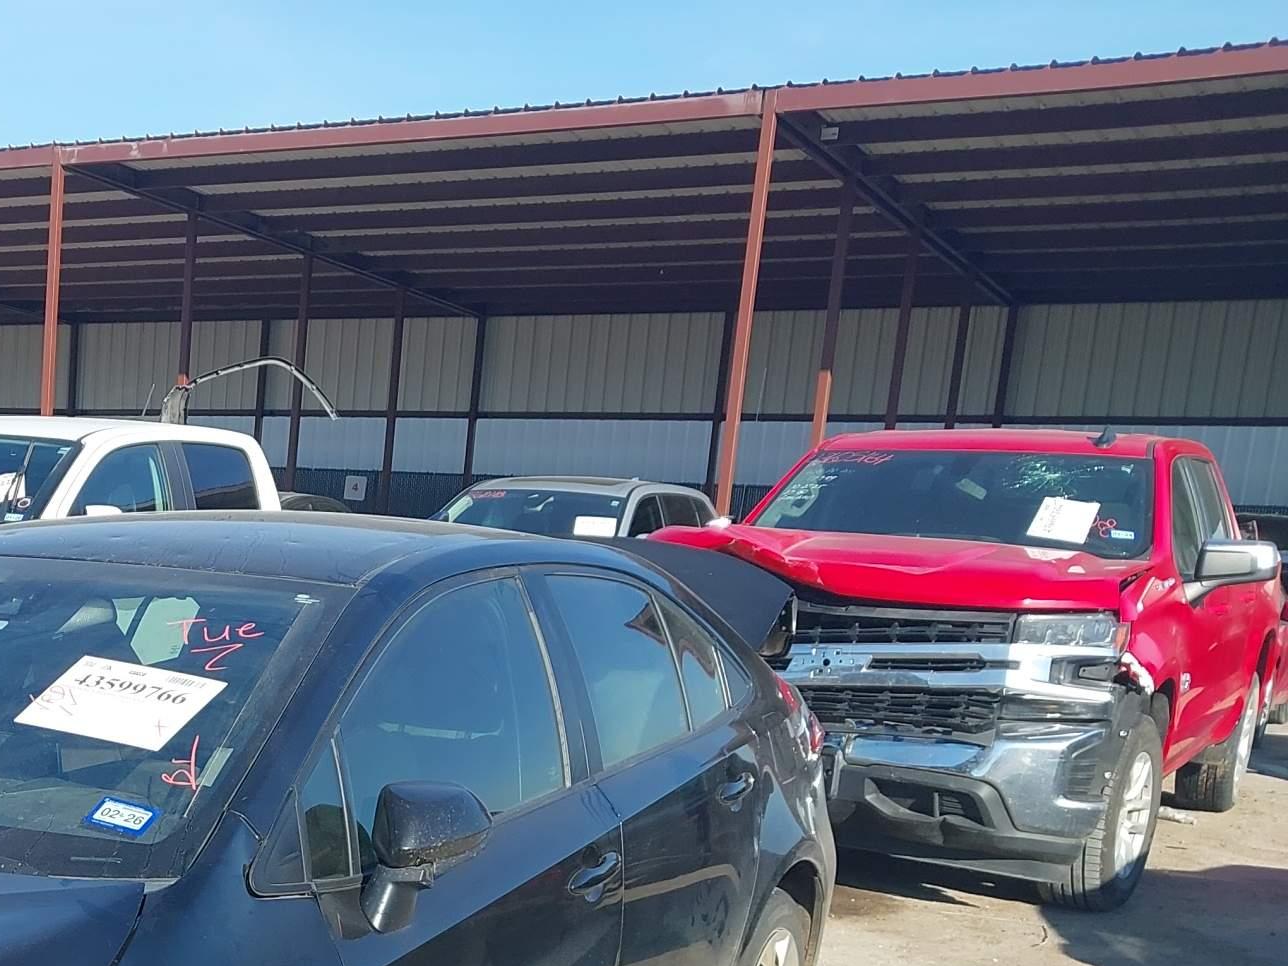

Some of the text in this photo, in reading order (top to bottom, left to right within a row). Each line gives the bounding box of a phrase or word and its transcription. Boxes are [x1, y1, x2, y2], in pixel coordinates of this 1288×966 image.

[351, 482, 359, 492] 4
[167, 618, 265, 645] Tue
[74, 673, 191, 704] 43599766
